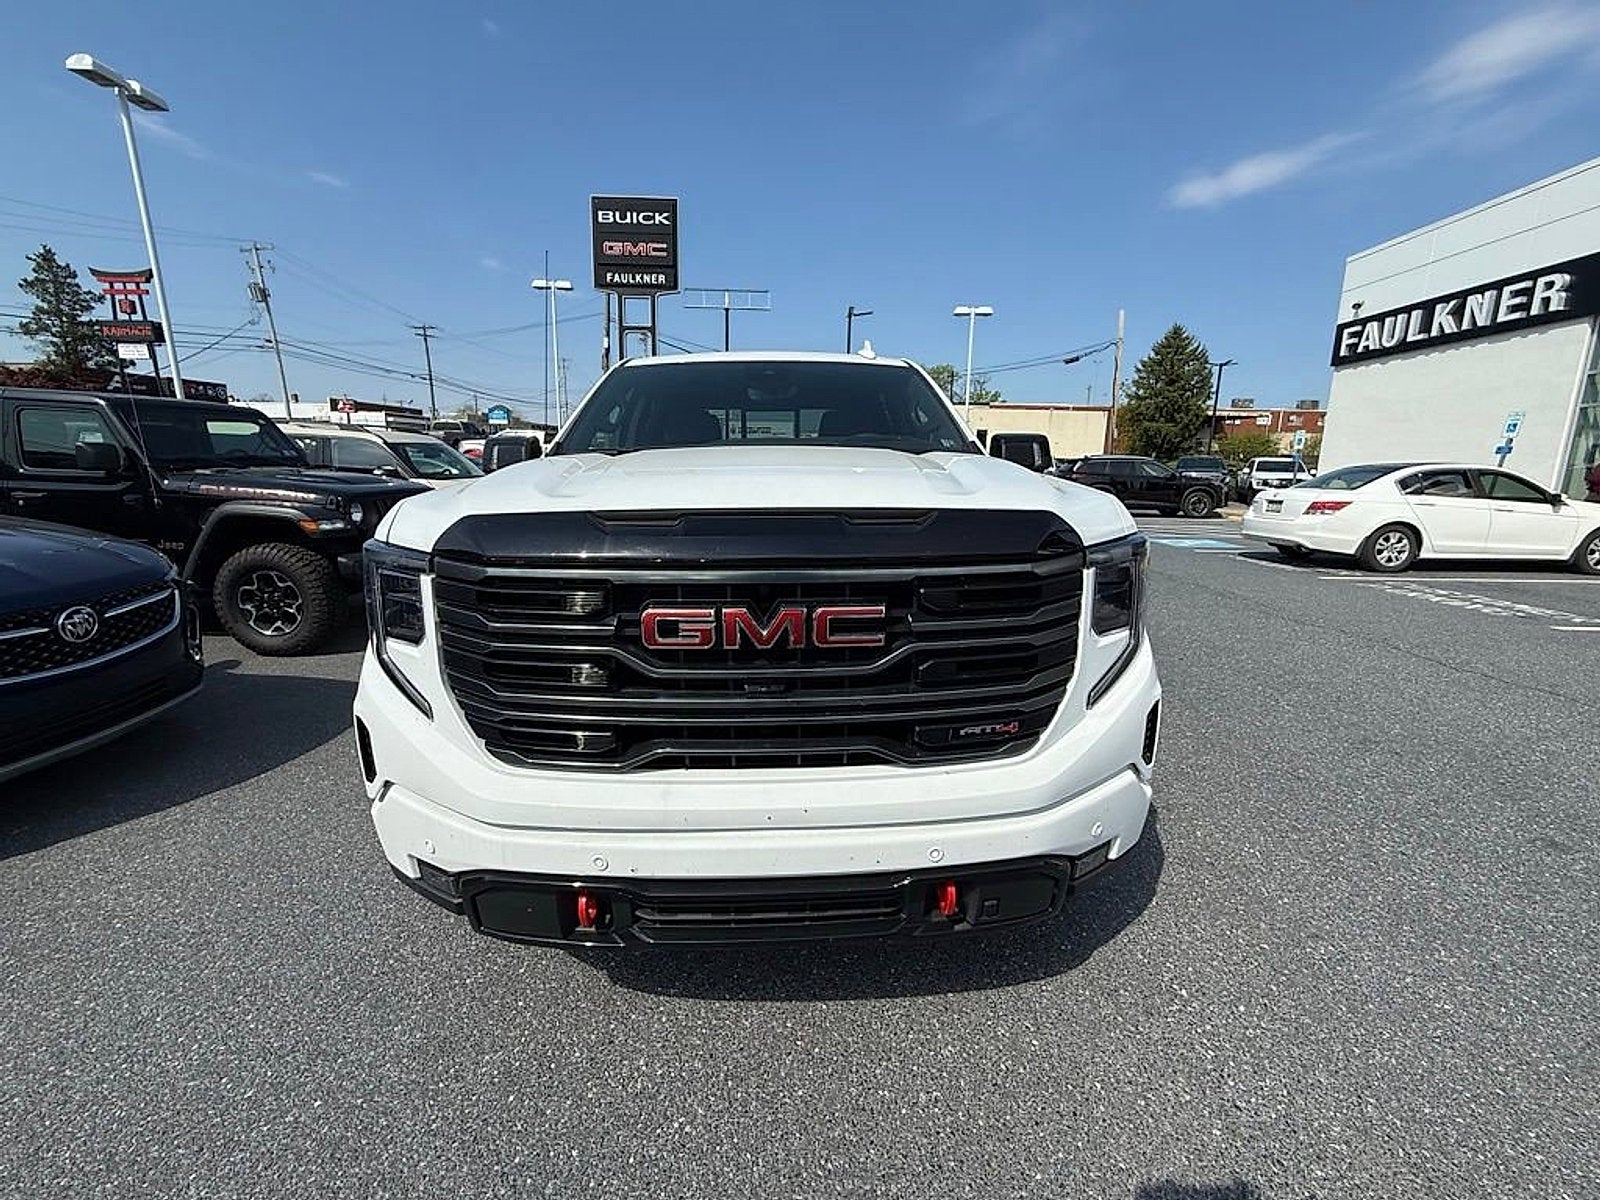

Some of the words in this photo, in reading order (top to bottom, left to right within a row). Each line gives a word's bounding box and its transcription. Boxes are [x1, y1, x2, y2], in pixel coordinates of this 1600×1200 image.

[597, 210, 672, 225] BUICK
[602, 241, 668, 257] GMC
[606, 271, 666, 285] FAULKNER
[1338, 272, 1574, 358] FAULKNER
[640, 603, 887, 650] GMC
